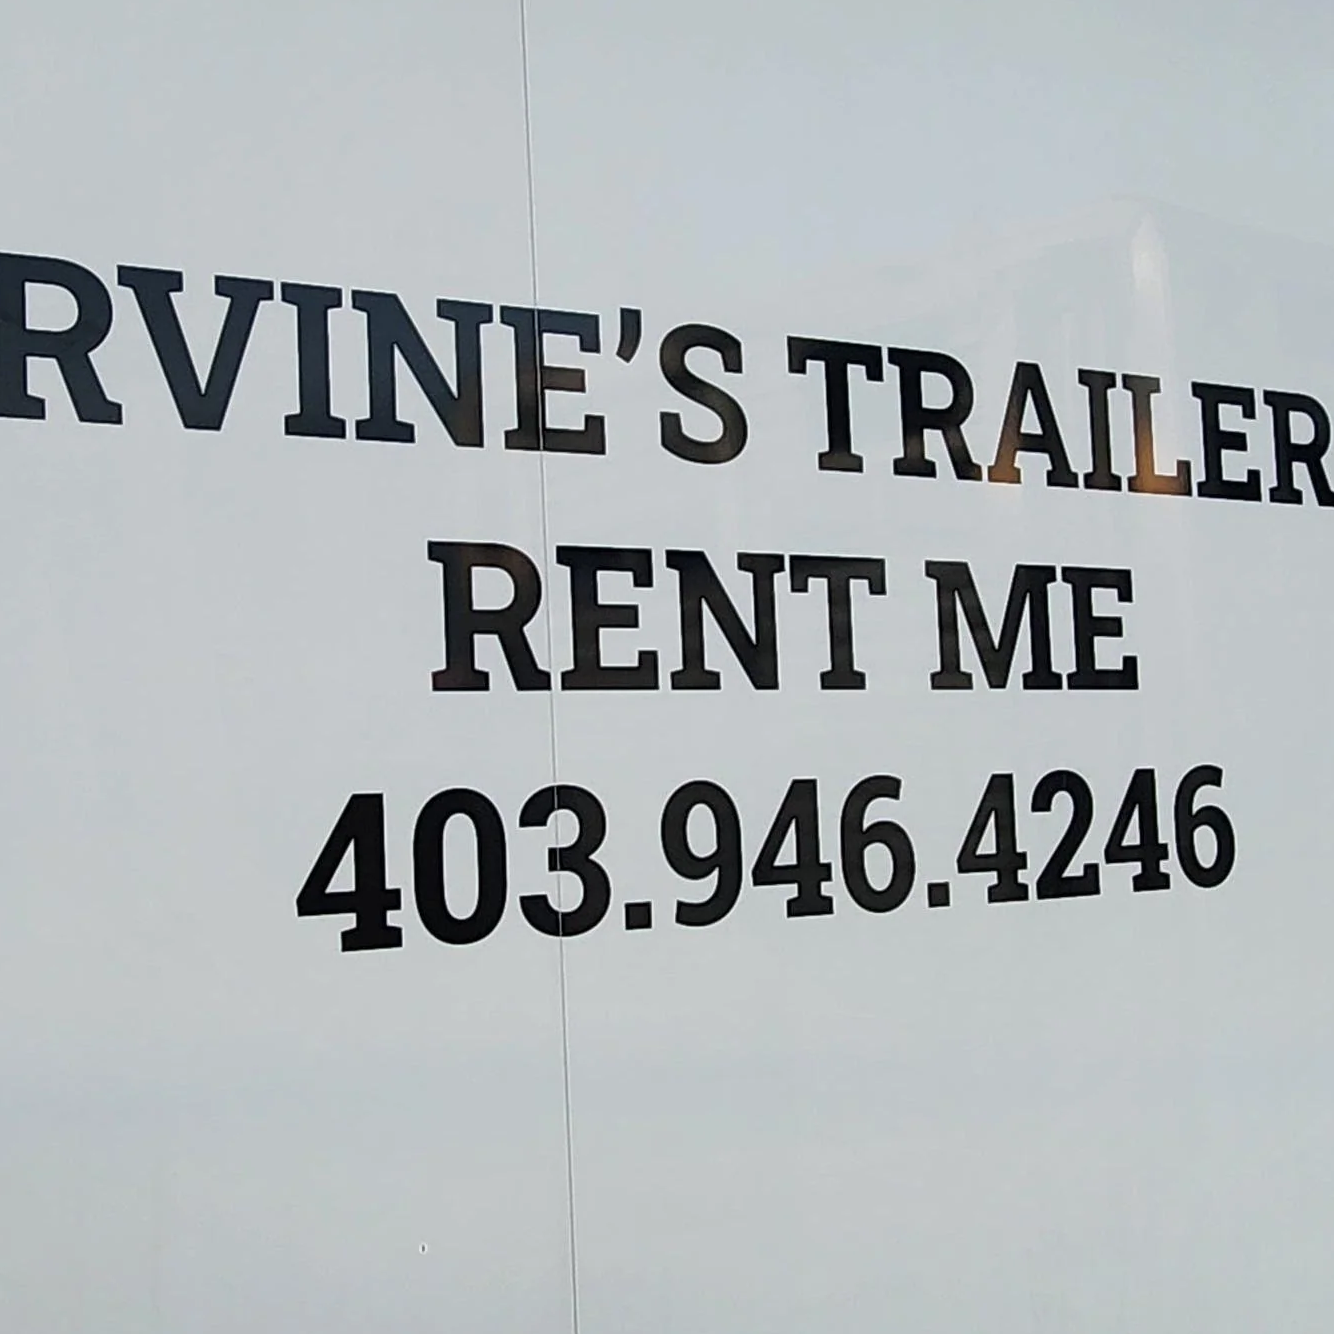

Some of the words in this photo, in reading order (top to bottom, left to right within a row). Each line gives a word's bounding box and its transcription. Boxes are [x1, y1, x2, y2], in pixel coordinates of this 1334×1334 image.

[427, 539, 887, 693] RENT
[923, 558, 1140, 692] ME
[295, 763, 1237, 953] 403.946.4246
